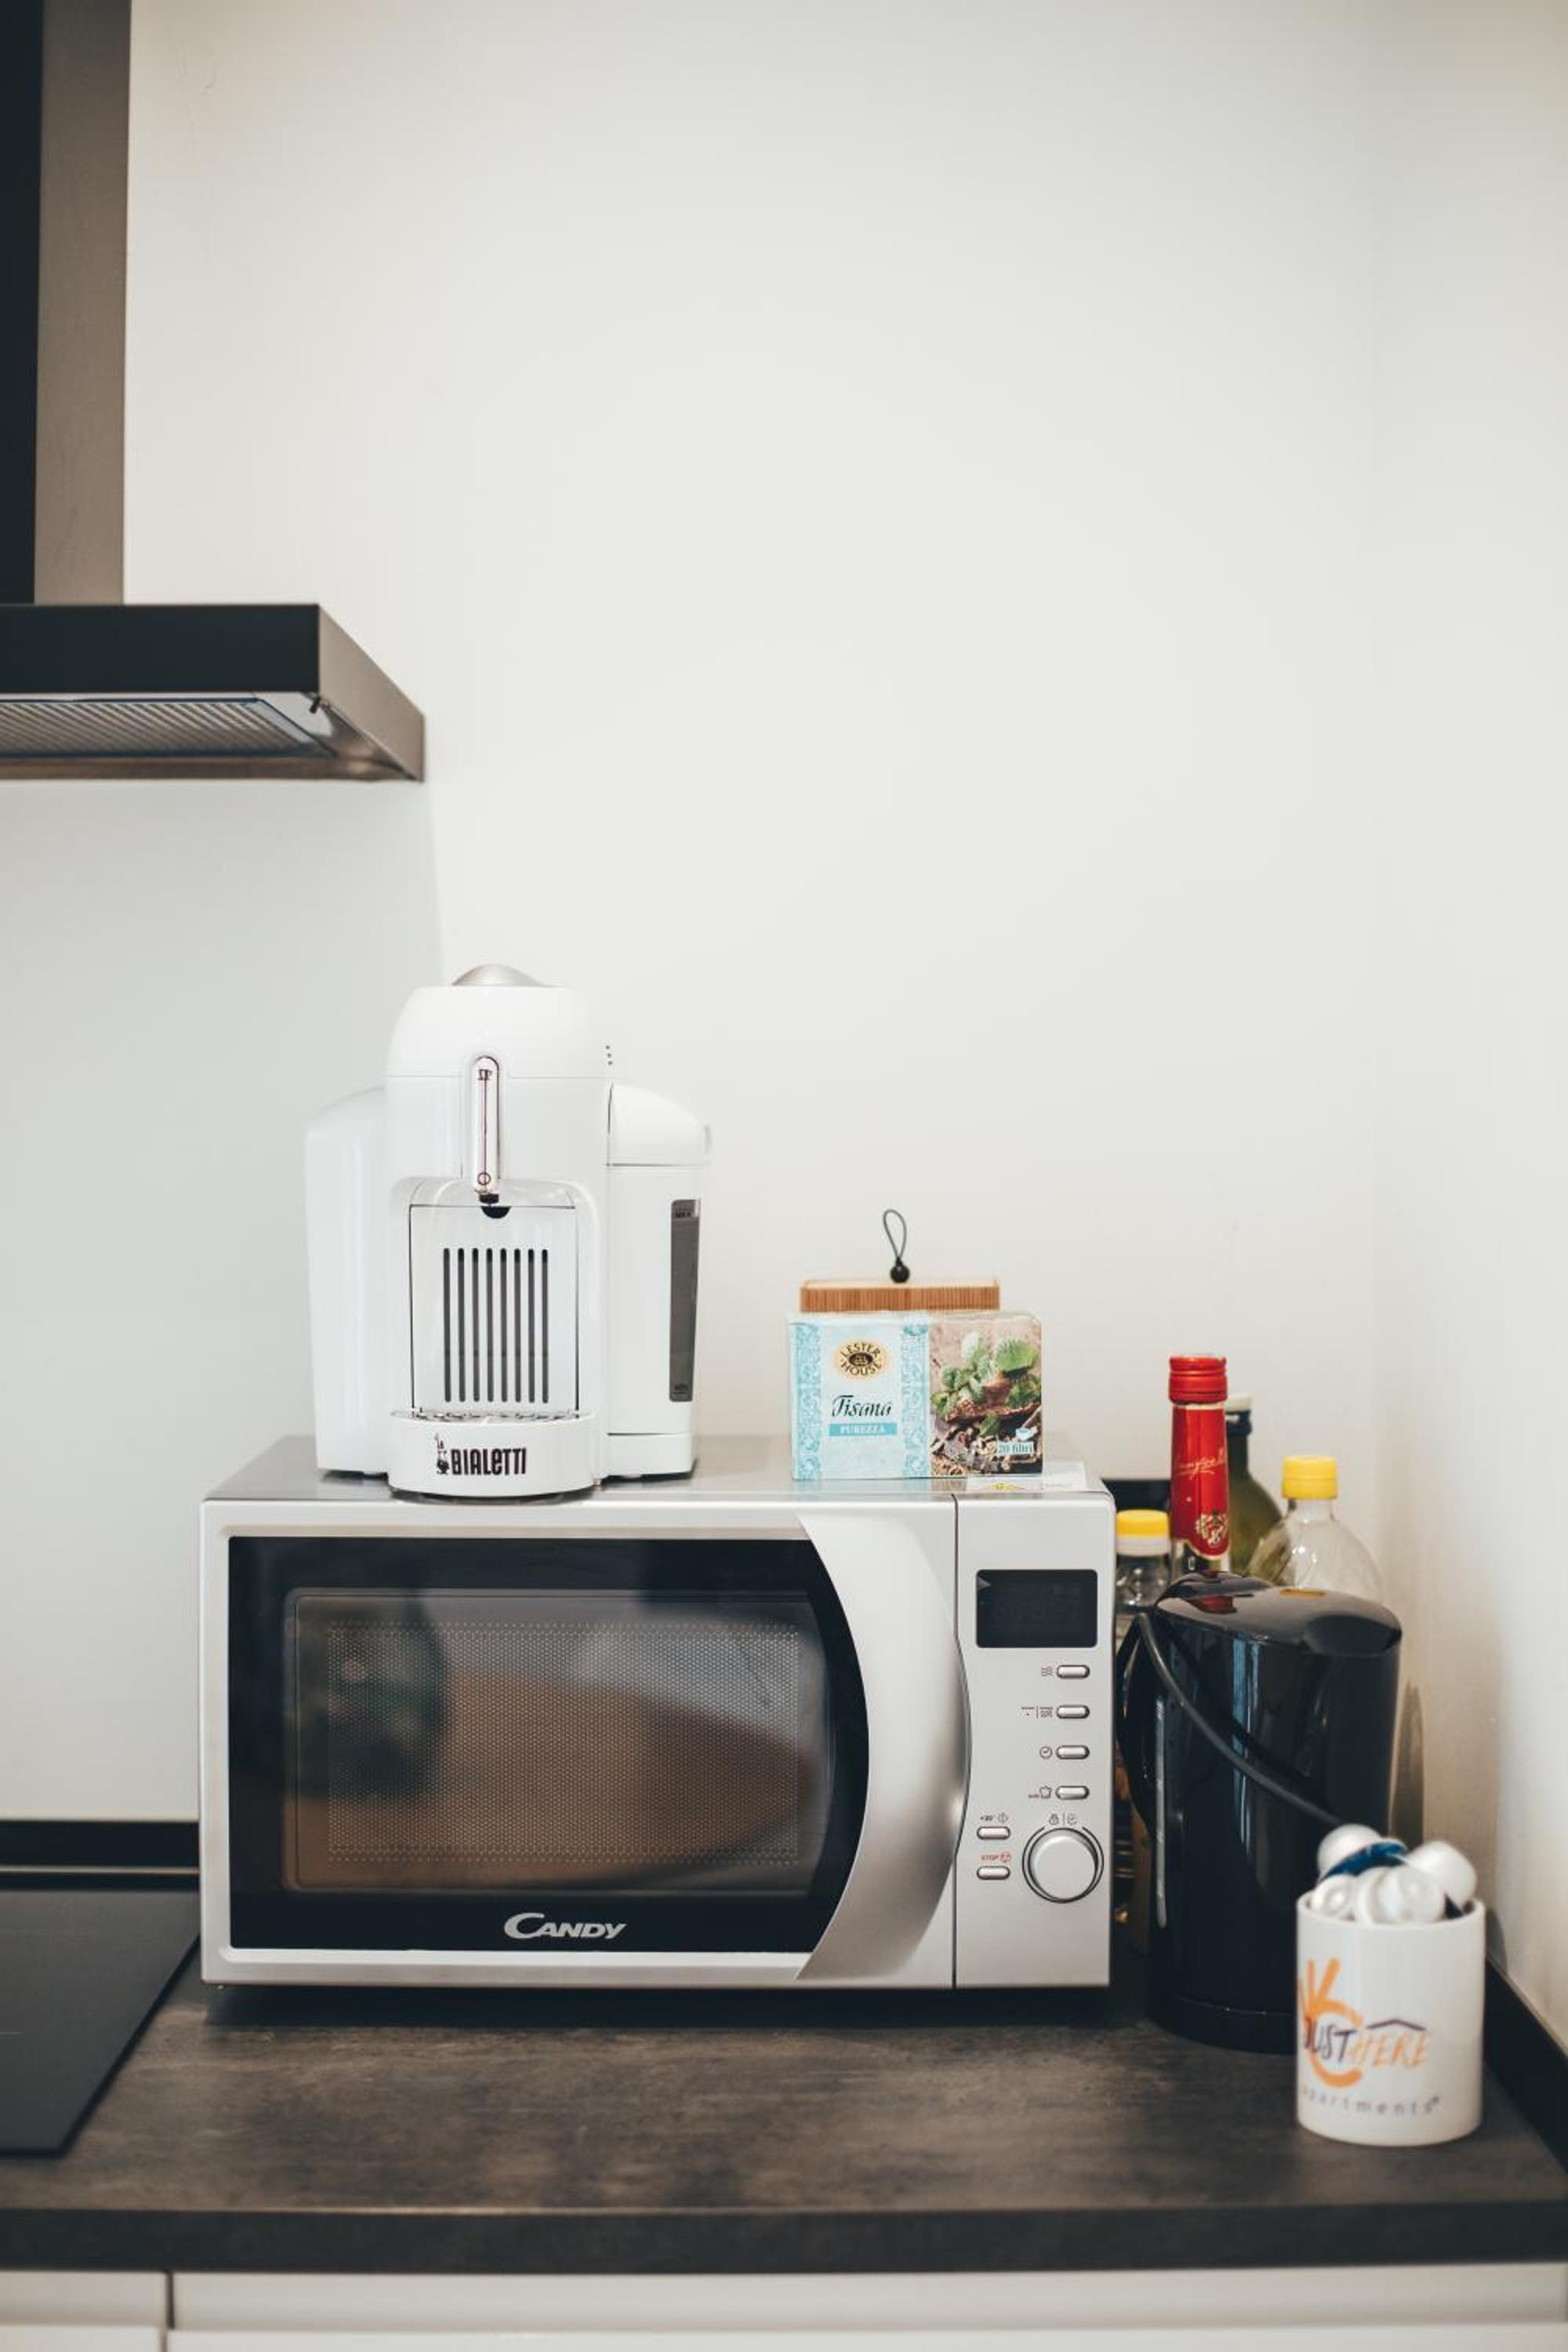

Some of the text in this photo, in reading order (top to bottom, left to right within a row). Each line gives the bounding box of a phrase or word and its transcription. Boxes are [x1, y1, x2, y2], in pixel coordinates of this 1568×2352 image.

[840, 1342, 880, 1358] LESTER
[840, 1361, 882, 1376] HOUSE
[503, 1911, 627, 1940] CANDY
